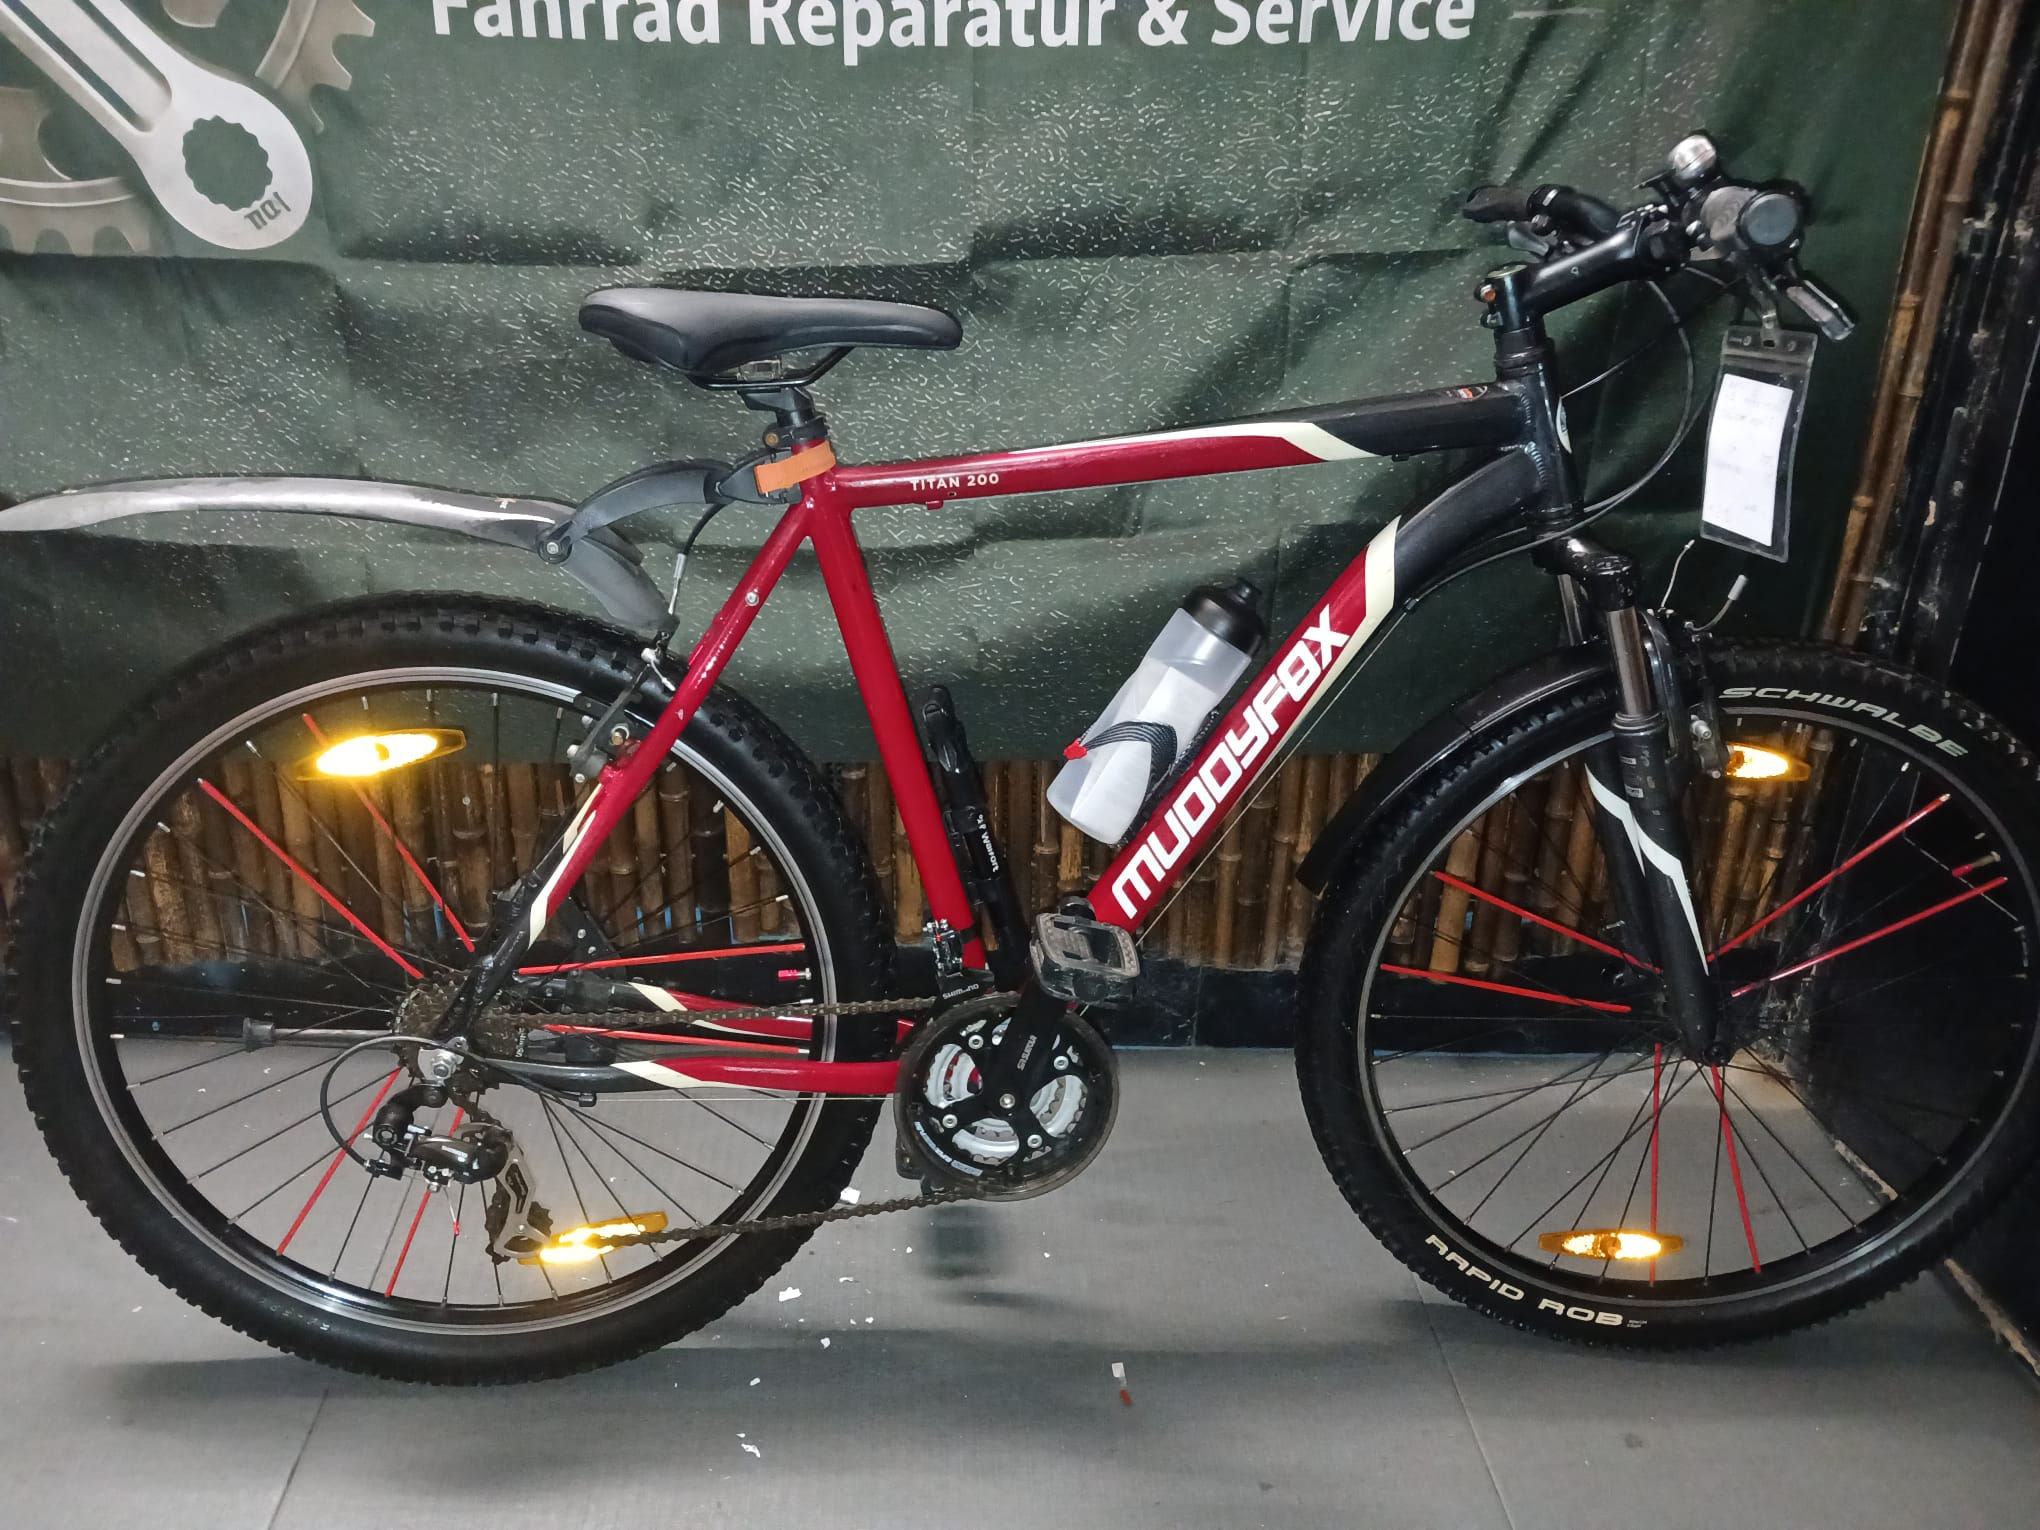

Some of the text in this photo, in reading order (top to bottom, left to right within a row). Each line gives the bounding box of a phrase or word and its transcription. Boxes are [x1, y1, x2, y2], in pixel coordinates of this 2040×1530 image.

[432, 0, 1475, 66] Fahrrad Reparatur & Service
[910, 472, 1000, 492] TITAN 200
[1718, 687, 1969, 758] SCHWALBE
[1424, 1234, 1624, 1327] RAPID ROB
